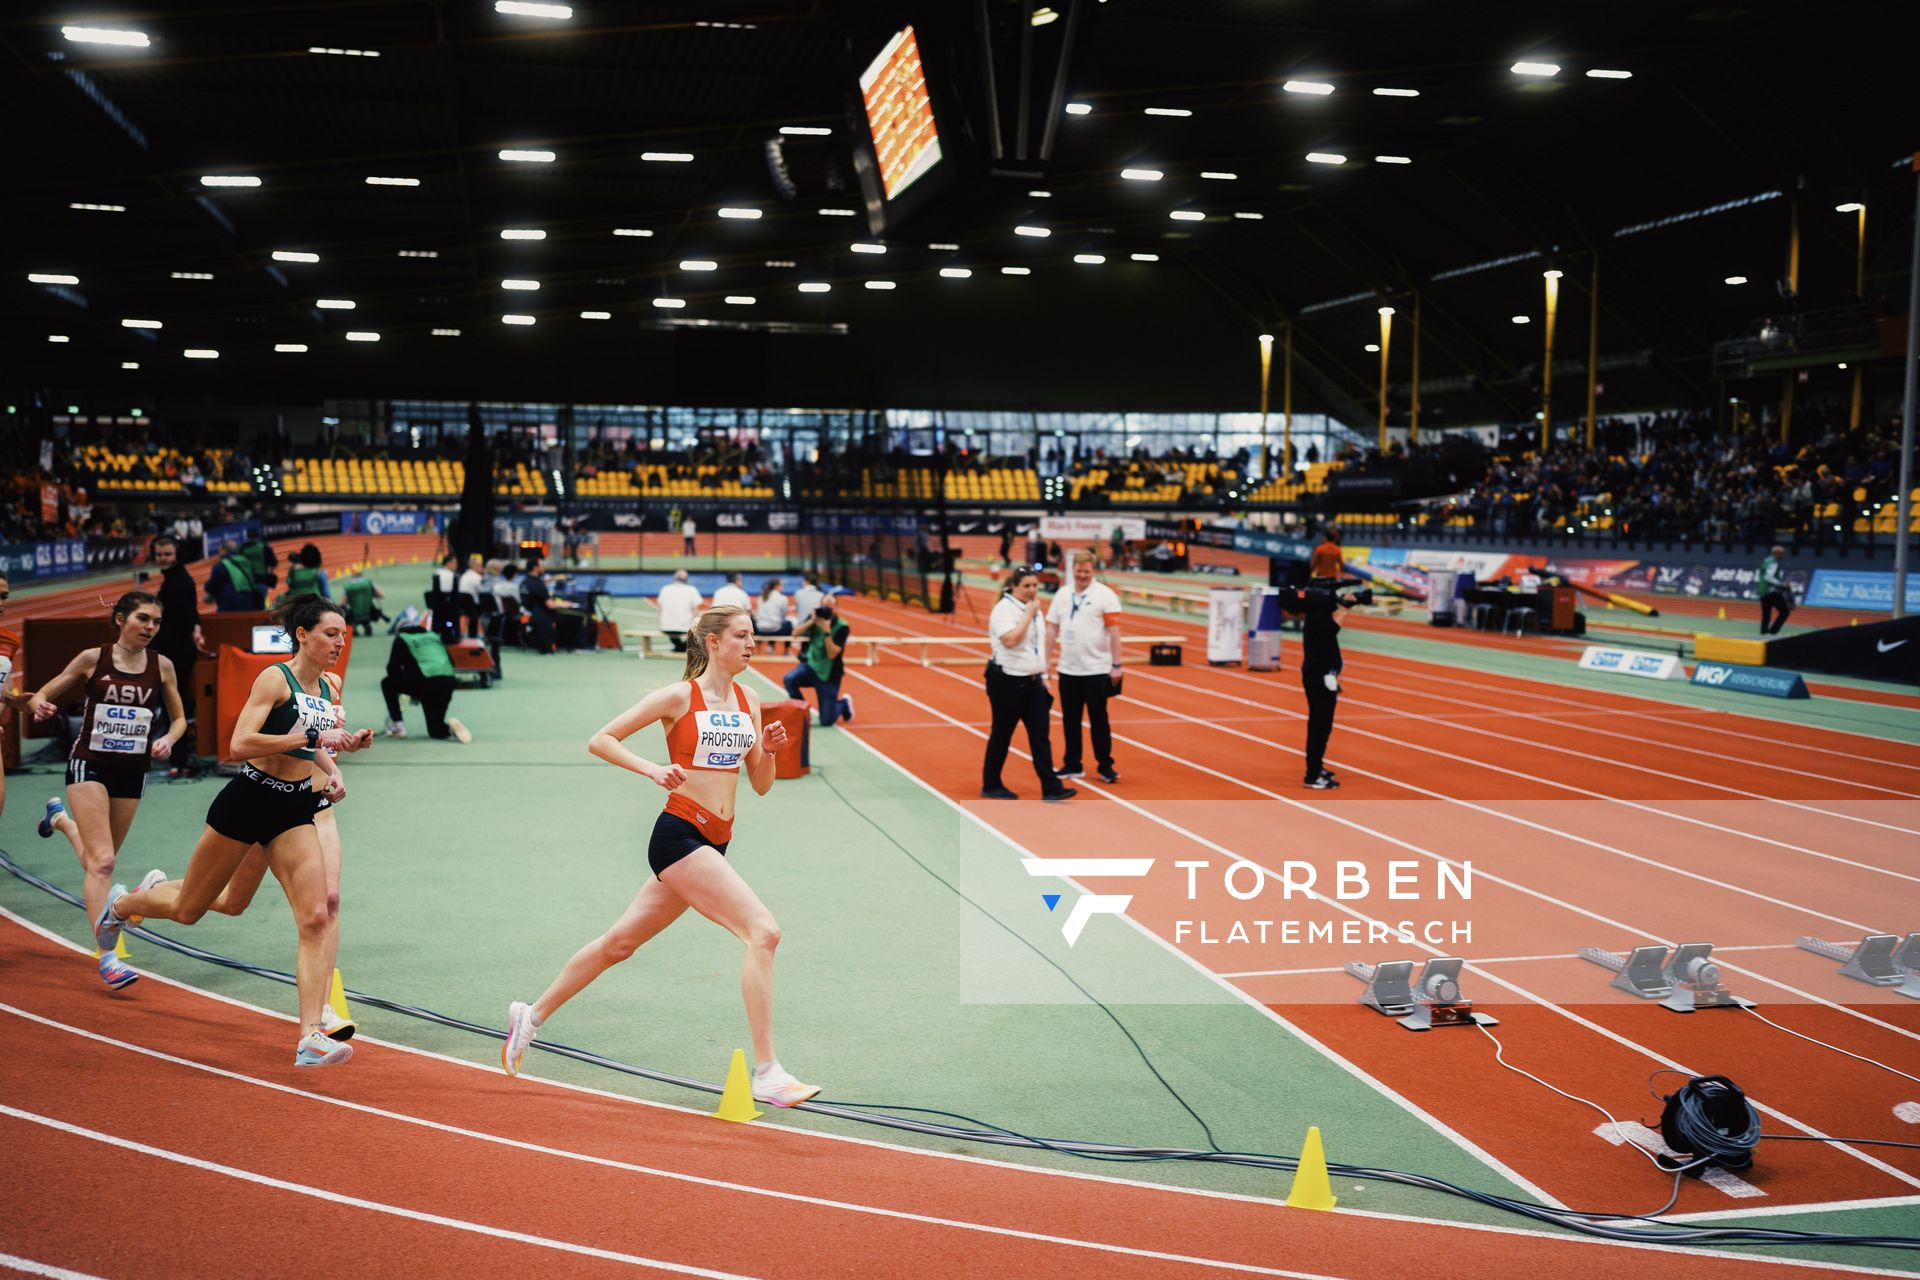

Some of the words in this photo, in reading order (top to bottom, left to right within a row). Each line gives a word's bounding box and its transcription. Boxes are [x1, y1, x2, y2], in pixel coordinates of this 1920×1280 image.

[1694, 665, 1733, 685] WGV
[104, 684, 153, 705] ASV
[96, 721, 147, 737] COUTELLIER
[261, 777, 295, 793] PRO
